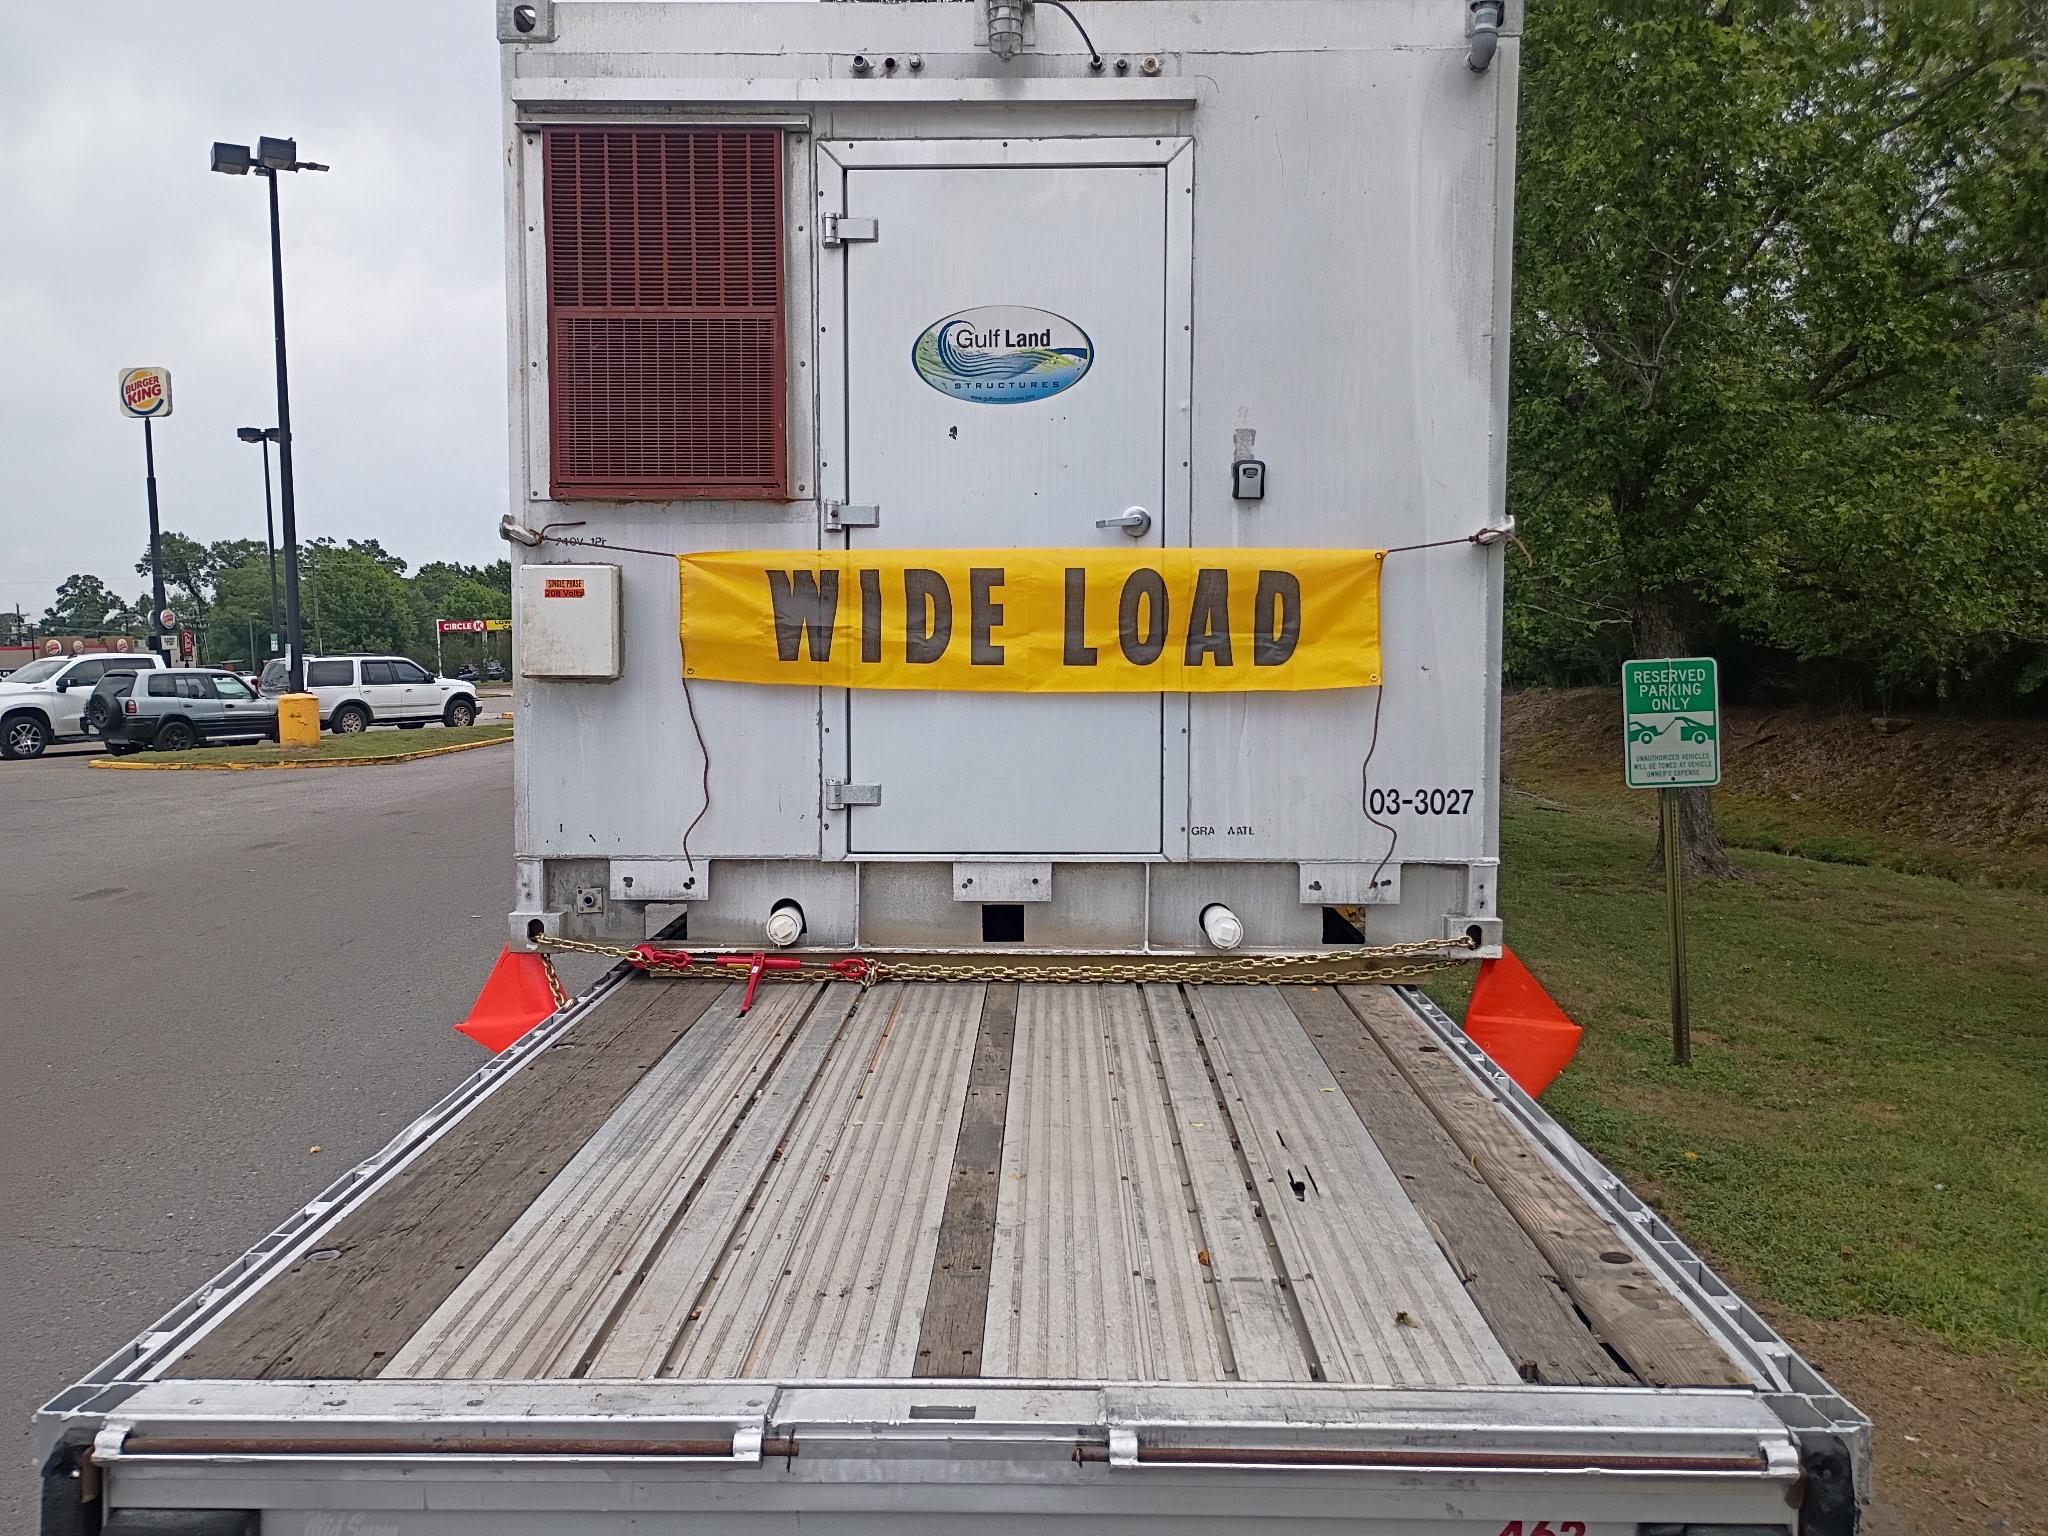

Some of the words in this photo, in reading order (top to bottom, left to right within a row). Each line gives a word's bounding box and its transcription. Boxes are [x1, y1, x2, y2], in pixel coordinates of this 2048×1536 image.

[956, 329, 1000, 348] Gulf
[1005, 329, 1050, 347] Land
[125, 376, 159, 394] BURGER
[954, 381, 1060, 389] STRUCTURES
[127, 384, 161, 406] KING
[548, 580, 565, 588] SINGLE
[567, 580, 582, 588] PHASE
[765, 568, 1004, 665] WIDE
[1063, 568, 1301, 666] LOAD
[443, 622, 472, 631] CIRCLE
[474, 620, 483, 631] K
[1633, 669, 1706, 683] RESERVED
[1640, 683, 1701, 697] PARKING
[1652, 697, 1690, 711] ONLY
[1636, 754, 1679, 762] UNAUTHORIZED
[1369, 788, 1474, 815] 03-3027
